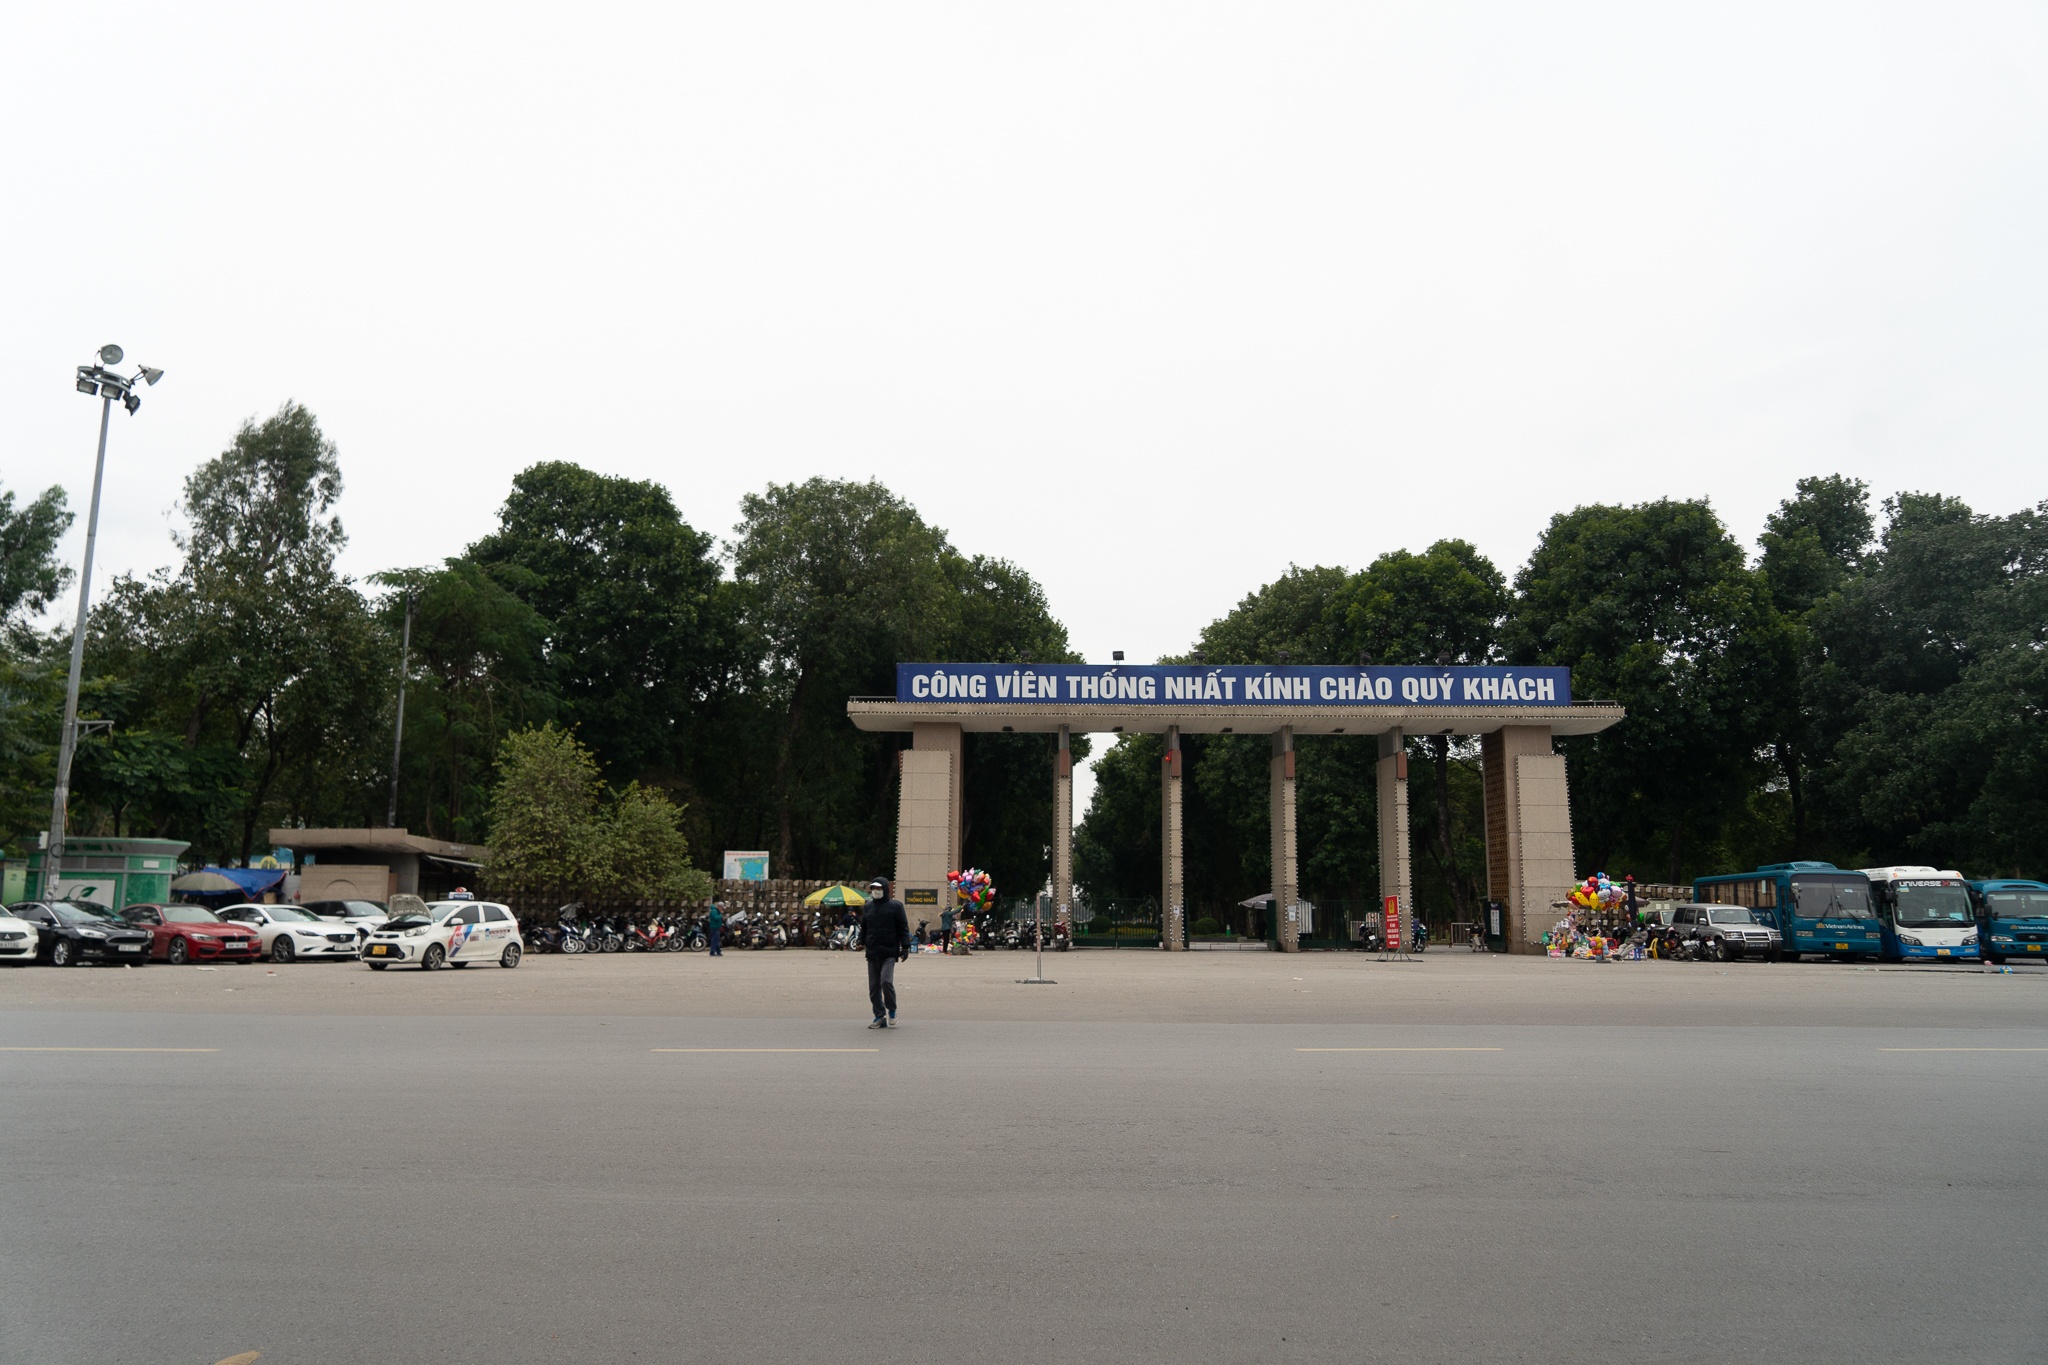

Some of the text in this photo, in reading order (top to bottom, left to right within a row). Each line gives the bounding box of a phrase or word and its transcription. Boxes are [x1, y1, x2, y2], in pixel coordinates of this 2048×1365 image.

[913, 670, 986, 698] CÔNG
[1066, 668, 1156, 699] THỐNG
[1165, 668, 1236, 699] NHẤT
[1245, 672, 1311, 700] KÍNH
[1320, 672, 1393, 700] CHÀO
[1402, 672, 1455, 703] QUÝ
[1463, 672, 1554, 701] KHÁCH
